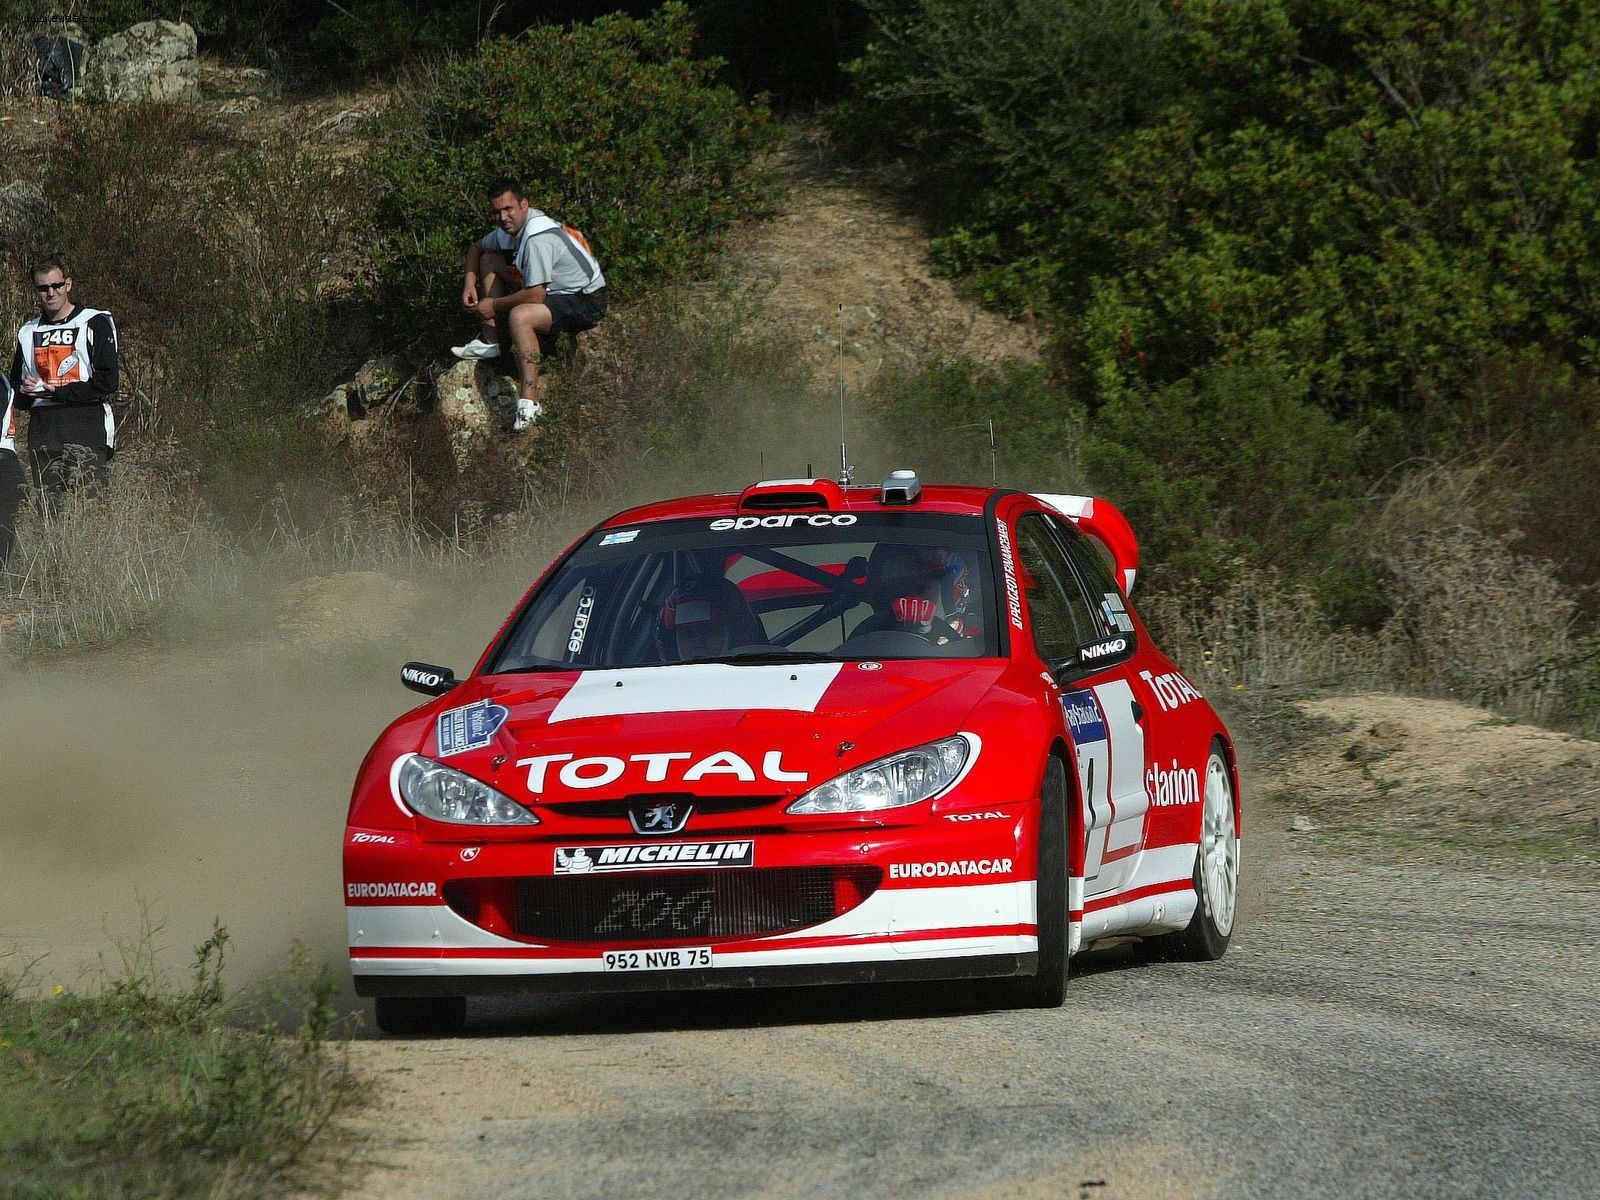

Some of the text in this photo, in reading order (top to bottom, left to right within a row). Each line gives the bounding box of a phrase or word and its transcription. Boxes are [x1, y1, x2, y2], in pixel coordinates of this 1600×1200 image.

[42, 330, 73, 346] 246
[710, 514, 858, 531] sparco
[568, 585, 594, 655] sparco
[1081, 639, 1126, 661] NIKKO
[402, 668, 439, 686] NIKKO
[1139, 670, 1203, 711] TOTAL
[515, 751, 808, 793] TOTAL
[1146, 759, 1200, 806] clarion
[943, 811, 1010, 823] TOTAL
[351, 833, 396, 844] TOTAL
[598, 842, 749, 864] MICHELIN
[889, 858, 1013, 879] EURODATACAR
[347, 882, 437, 898] EURODATACAR
[606, 949, 710, 970] 952 NVB 75
